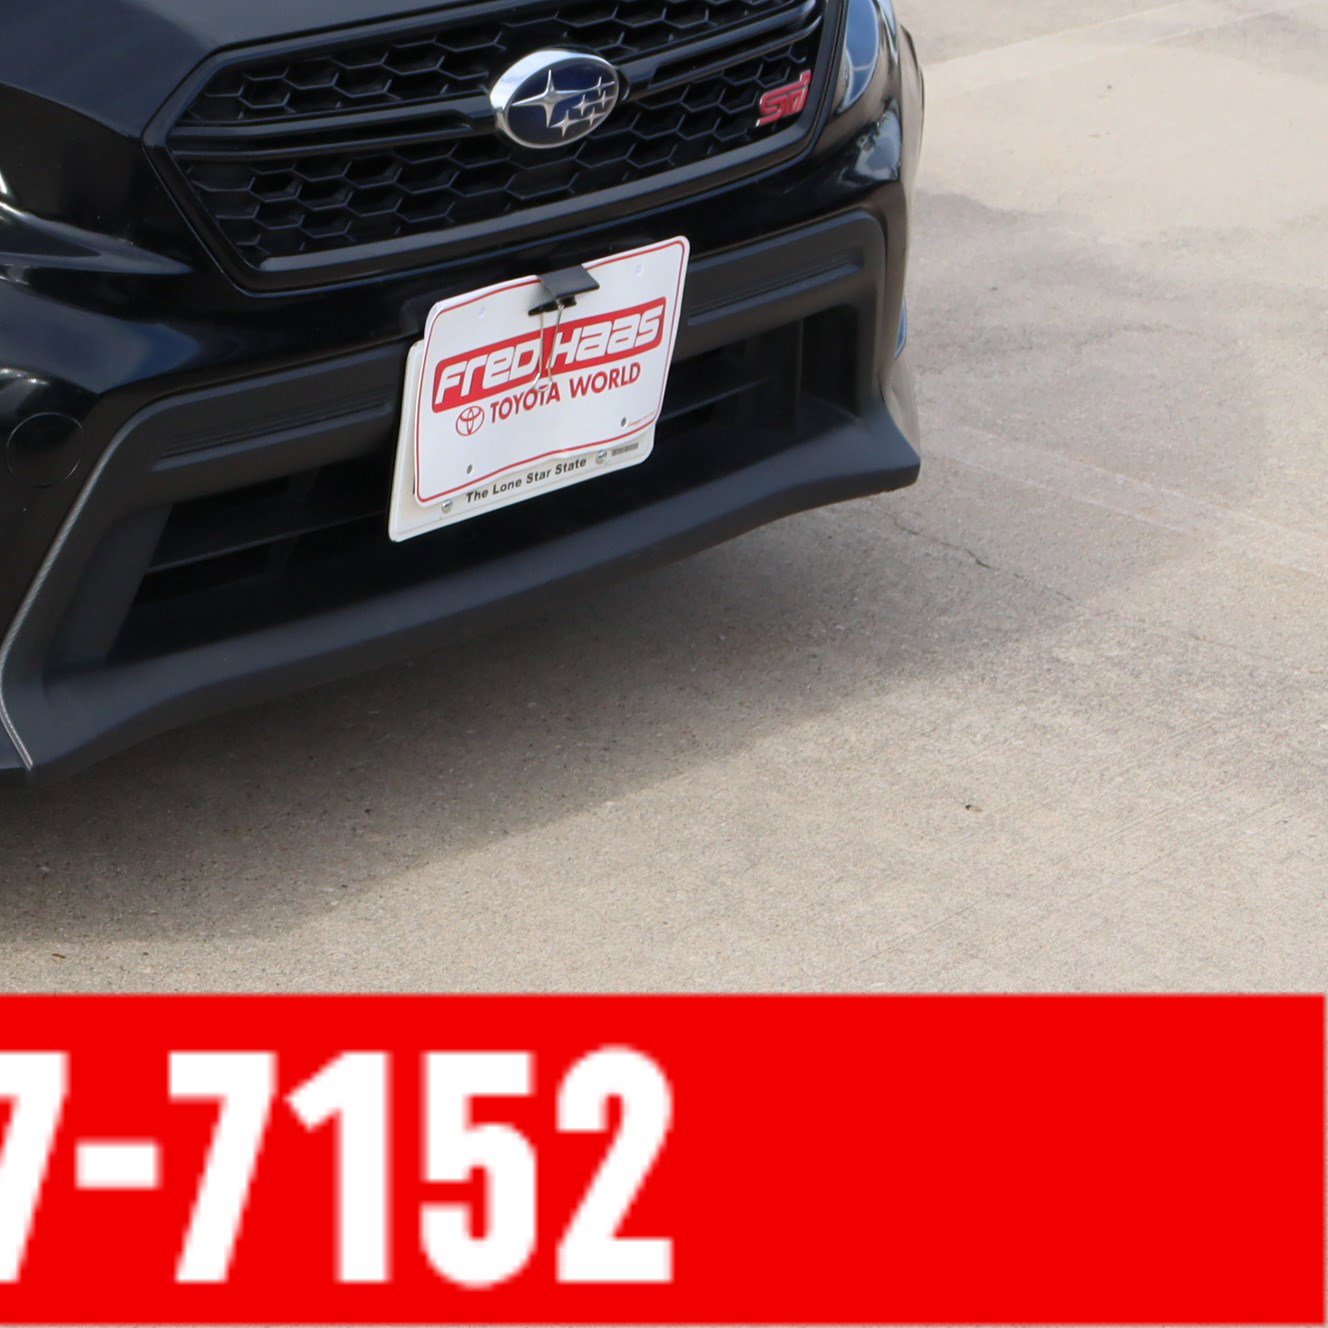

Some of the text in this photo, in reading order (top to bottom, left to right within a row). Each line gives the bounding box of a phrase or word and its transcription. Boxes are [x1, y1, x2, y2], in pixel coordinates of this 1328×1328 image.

[490, 361, 642, 424] TOYOTA WORLD
[465, 458, 587, 504] The Lone Star State
